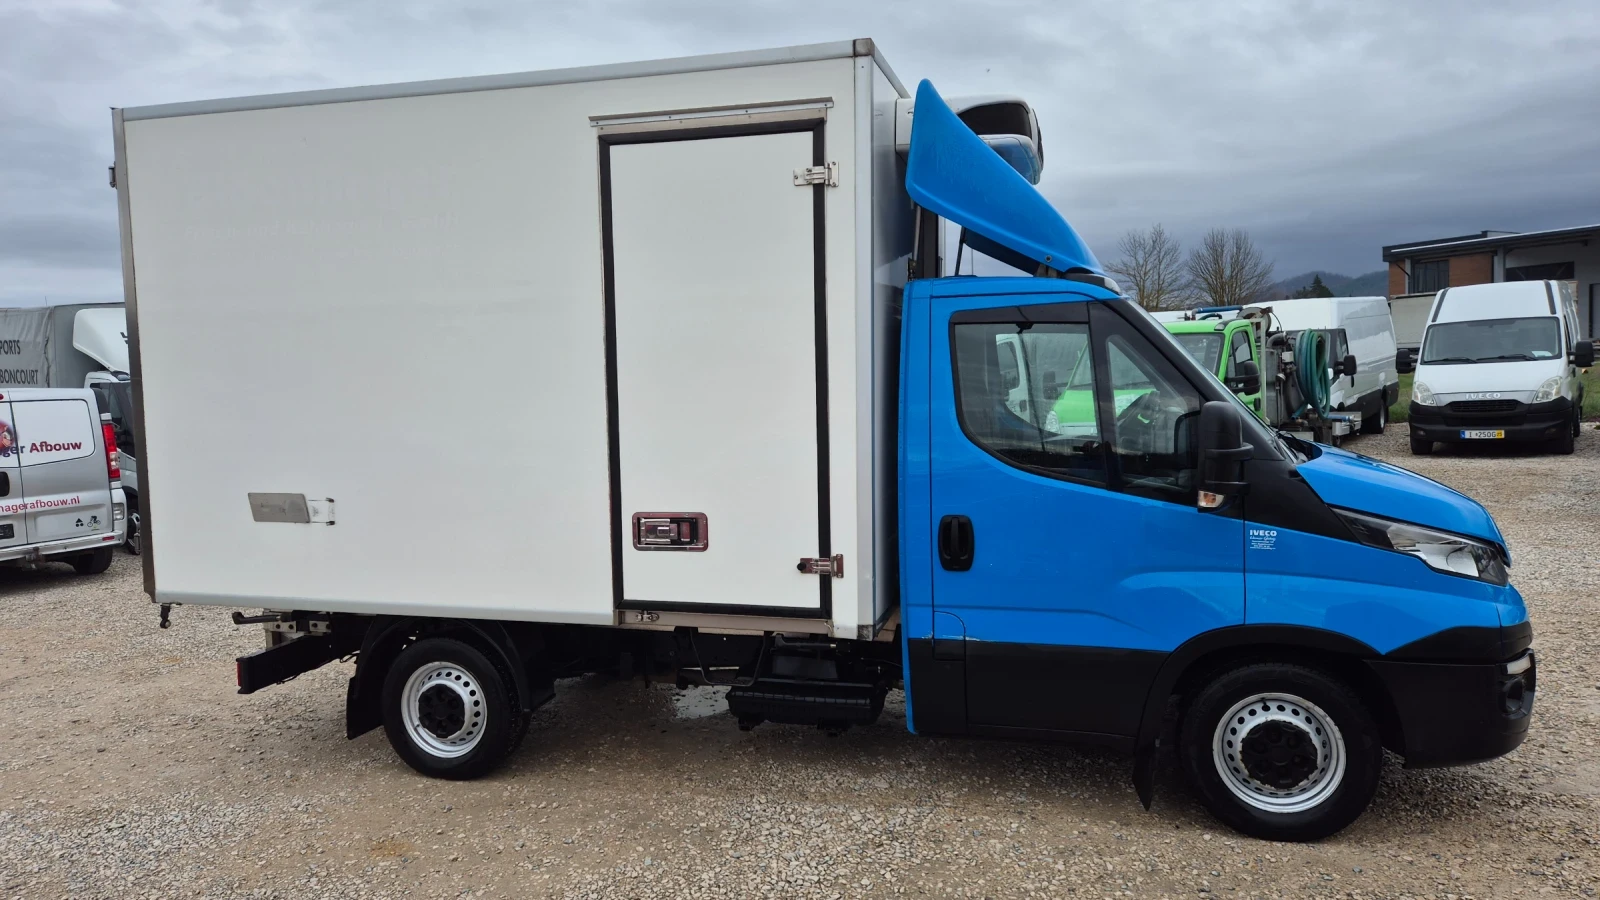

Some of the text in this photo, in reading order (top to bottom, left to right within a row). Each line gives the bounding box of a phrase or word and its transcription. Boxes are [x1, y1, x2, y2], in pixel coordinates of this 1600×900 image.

[0, 368, 39, 385] BONCOURT
[1465, 392, 1501, 400] IVECO
[0, 441, 82, 458] ger Afbouw
[1249, 529, 1277, 537] IVECO
